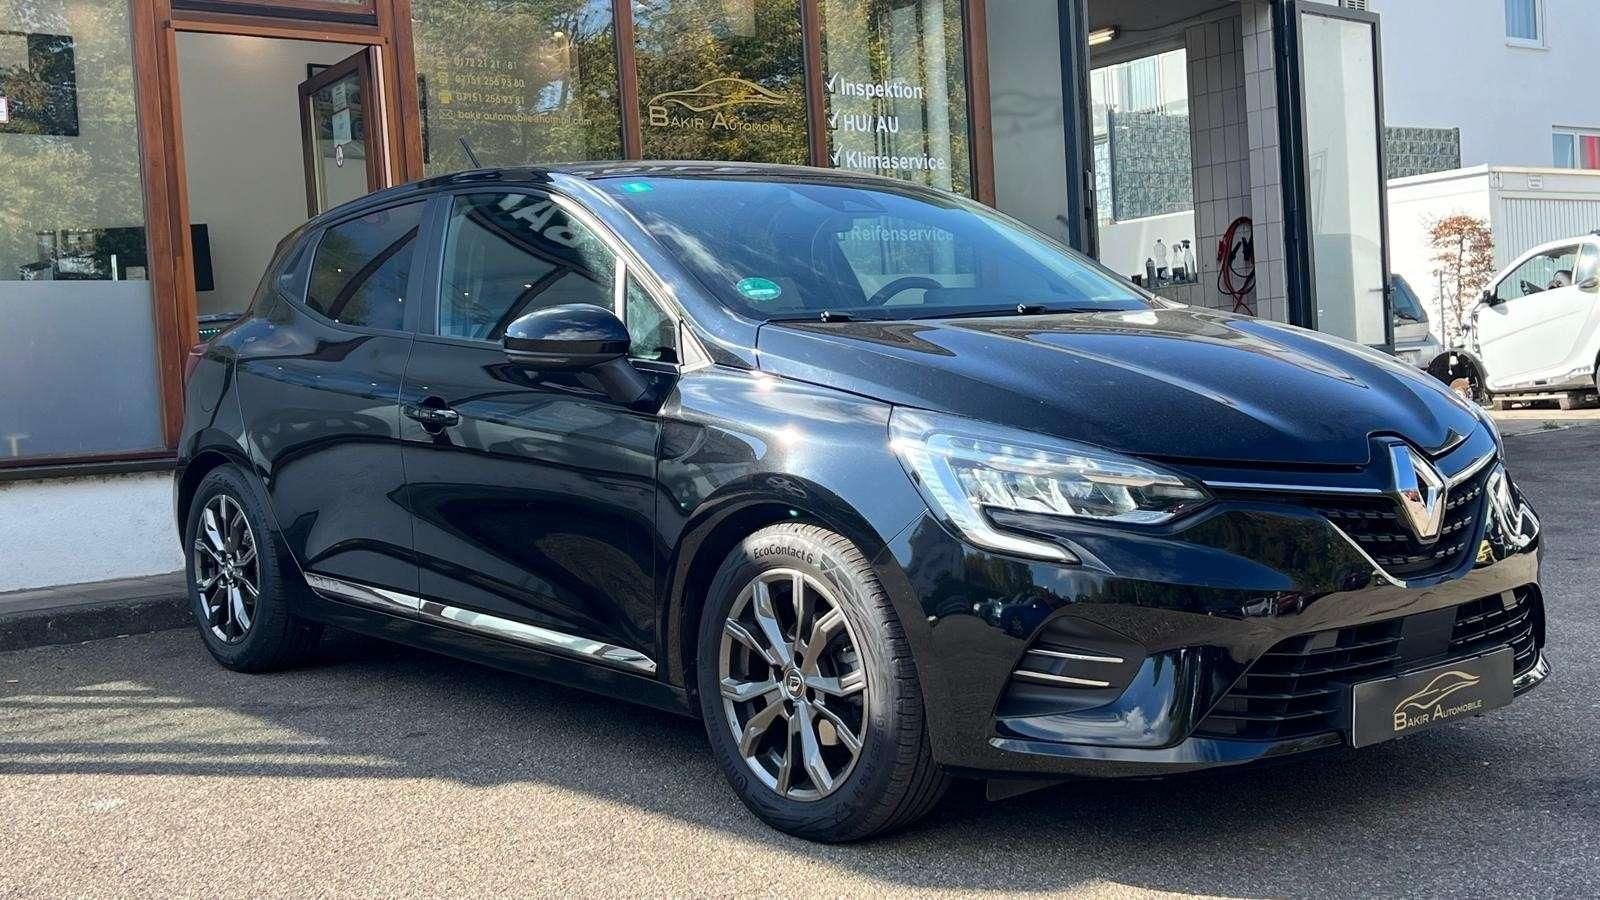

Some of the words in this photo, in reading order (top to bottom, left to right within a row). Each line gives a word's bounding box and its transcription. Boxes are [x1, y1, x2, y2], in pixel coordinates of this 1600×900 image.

[840, 78, 923, 99] Inspektion
[649, 105, 705, 128] BAKIR
[711, 111, 795, 132] AUTOMOBILE
[875, 116, 900, 133] AU
[845, 151, 945, 170] Klimaservice
[851, 224, 955, 241] Reifenservice
[753, 543, 806, 560] EcoContact
[806, 552, 814, 564] 6
[1393, 711, 1430, 731] BAKIR
[1432, 699, 1483, 721] AUTOMOBILE
